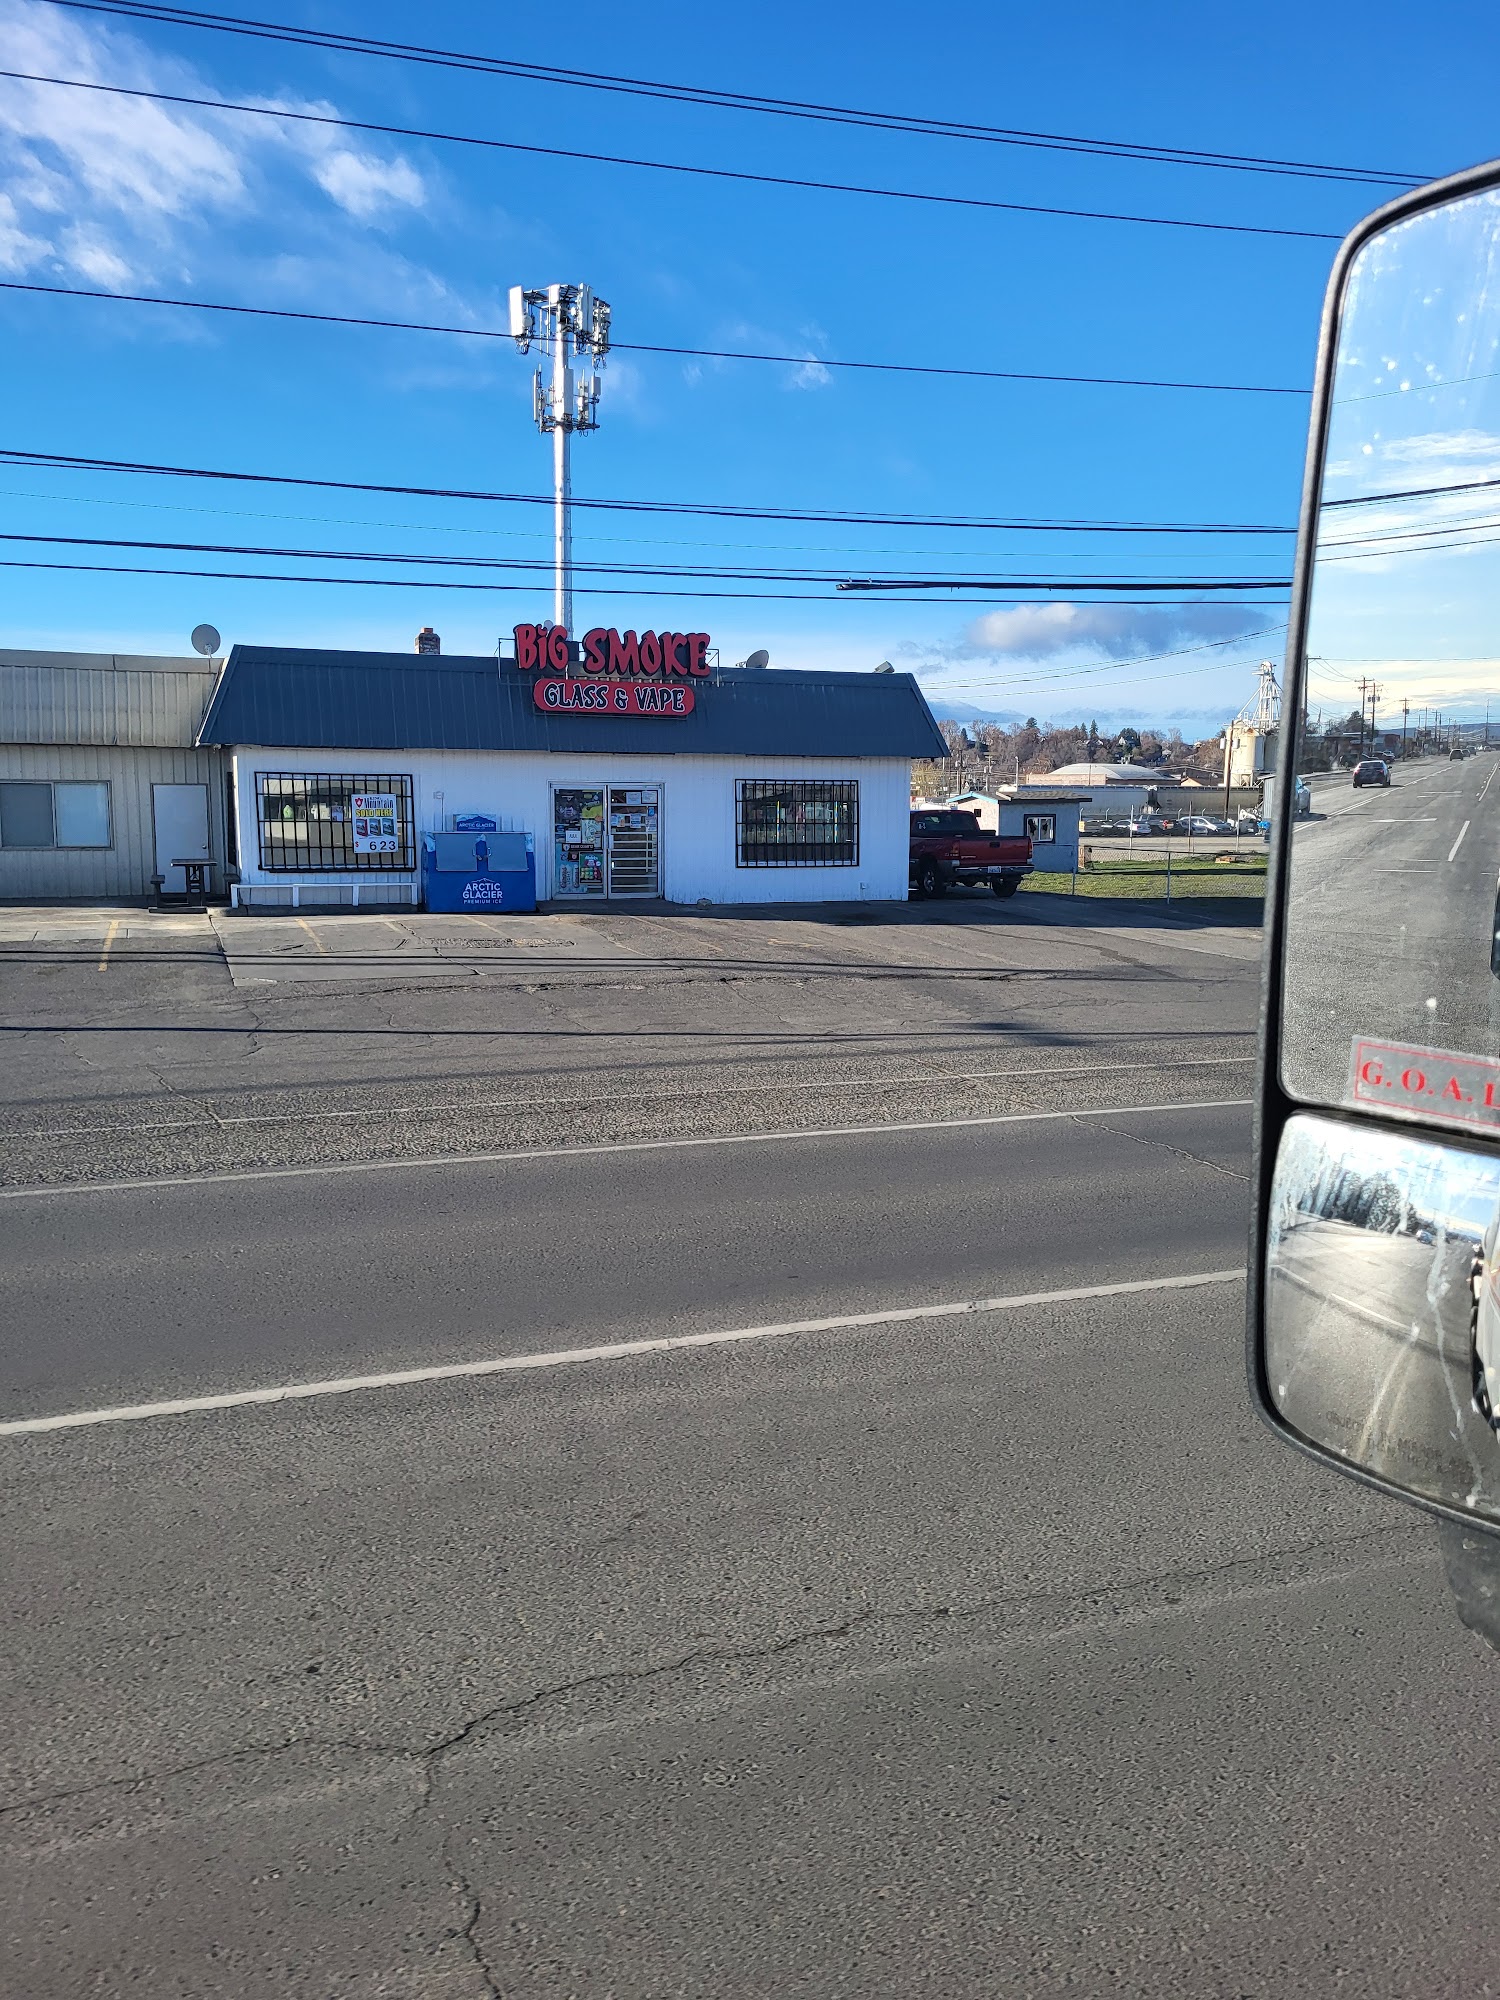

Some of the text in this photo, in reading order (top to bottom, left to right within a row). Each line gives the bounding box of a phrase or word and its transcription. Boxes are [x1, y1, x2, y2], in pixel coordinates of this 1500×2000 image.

[583, 628, 710, 677] SMOKE
[543, 682, 685, 712] GLASS & VAPE
[355, 809, 393, 817] SOLD HERE
[465, 883, 501, 891] ARCTIC
[462, 890, 503, 899] GLACIER
